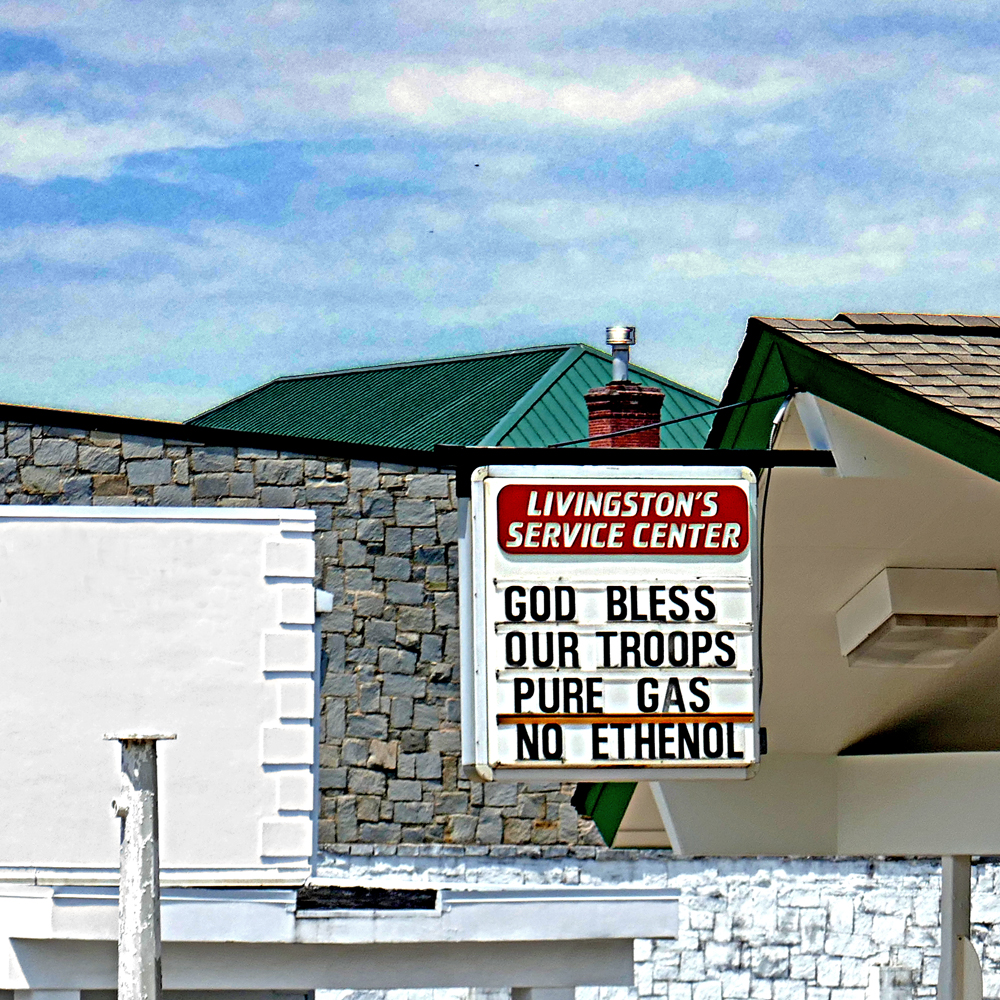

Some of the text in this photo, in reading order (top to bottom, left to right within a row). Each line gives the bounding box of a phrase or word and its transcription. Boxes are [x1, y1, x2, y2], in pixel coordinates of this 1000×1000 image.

[527, 490, 719, 517] LIVINGSTON'S
[506, 522, 742, 549] SERVICE CENTER
[504, 585, 716, 622] GOD BLESS
[505, 630, 736, 668] OUR TROOPS
[513, 677, 711, 714] PURE GAS
[516, 722, 745, 760] NO ETHENOL
